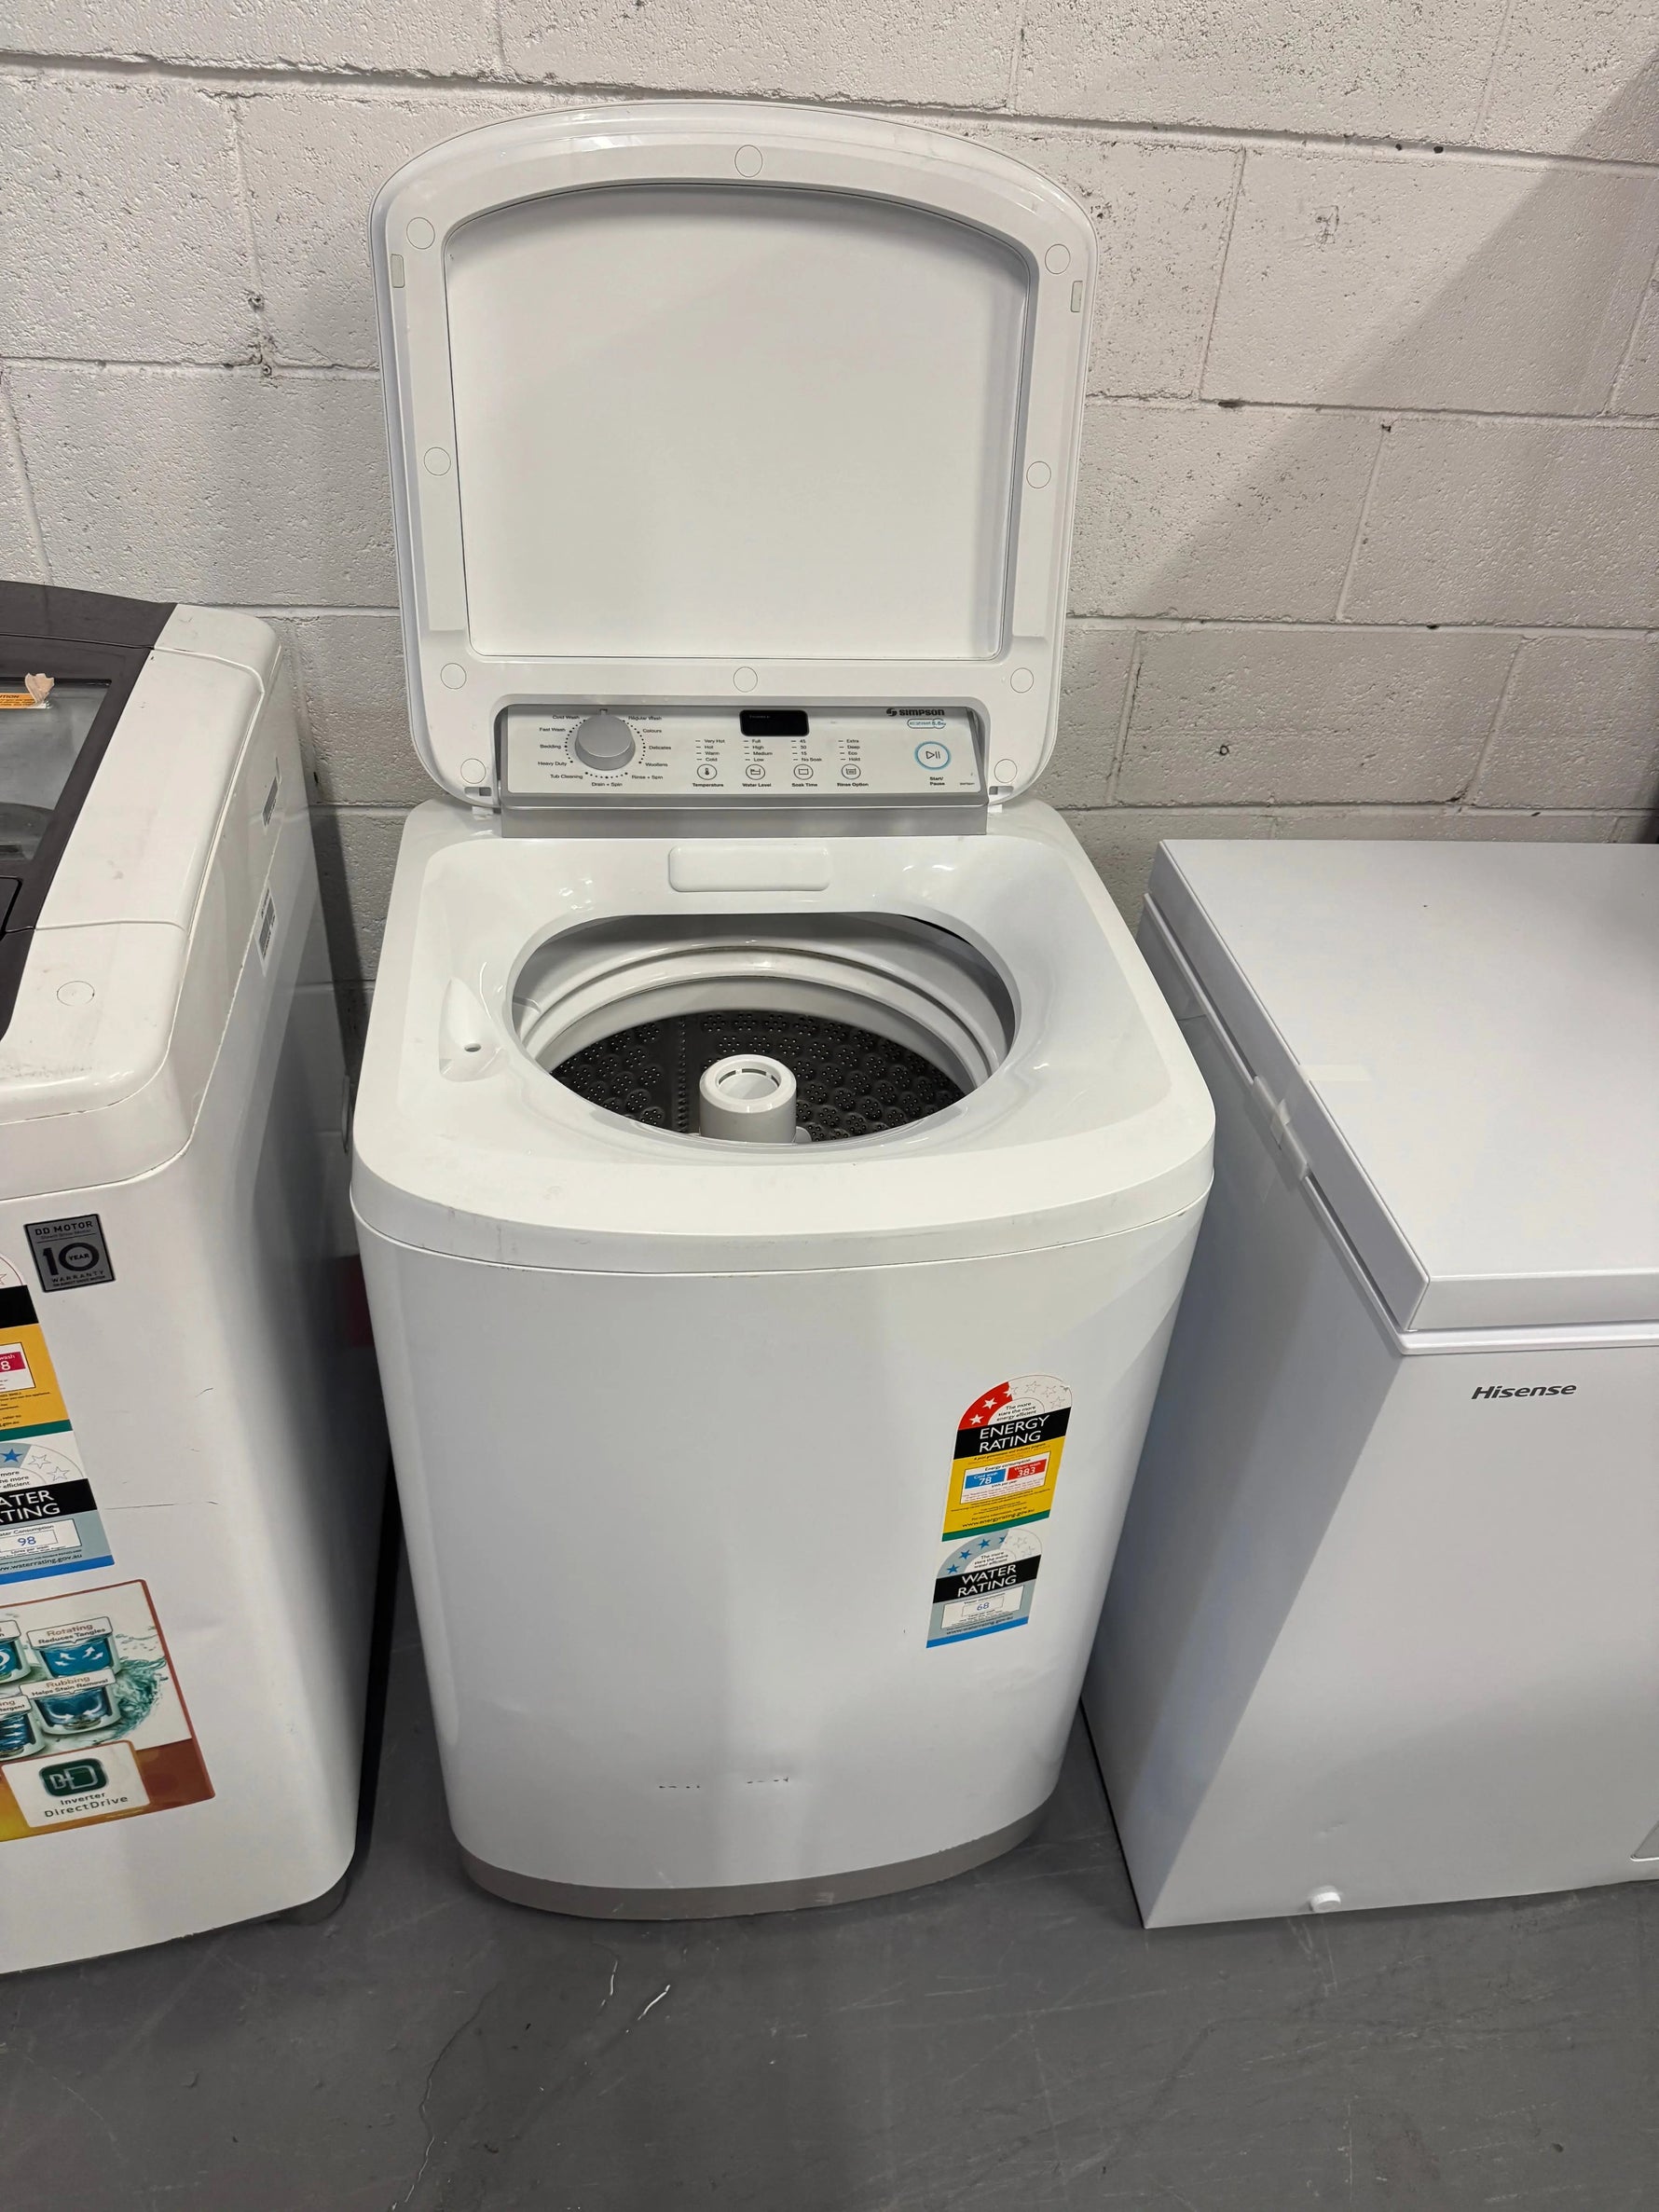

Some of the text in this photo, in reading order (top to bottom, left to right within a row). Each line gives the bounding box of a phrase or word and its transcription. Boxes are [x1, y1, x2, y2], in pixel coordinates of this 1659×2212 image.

[54, 1220, 93, 1232] MOTOR
[43, 1243, 100, 1276] 10
[68, 1253, 89, 1261] YEAR
[52, 1271, 104, 1283] WARRANTY
[1471, 1384, 1577, 1399] Hisense
[980, 1415, 1050, 1439] ENERGY
[979, 1430, 1041, 1453] RATING
[1017, 1467, 1035, 1477] 383
[979, 1477, 992, 1486] 78
[13, 1525, 54, 1534] Consumption
[18, 1536, 36, 1546] 98
[962, 1564, 1017, 1585] WATER
[957, 1575, 1017, 1598] RATING
[977, 1602, 990, 1611] 68
[38, 1628, 105, 1644] Reduces Tangles
[47, 1624, 93, 1637] Rotating
[32, 1688, 53, 1697] Helps
[76, 1679, 108, 1687] Removal
[46, 1676, 90, 1688] Rubbing
[61, 1793, 105, 1806] Inverter
[44, 1796, 128, 1818] DirectDrive
